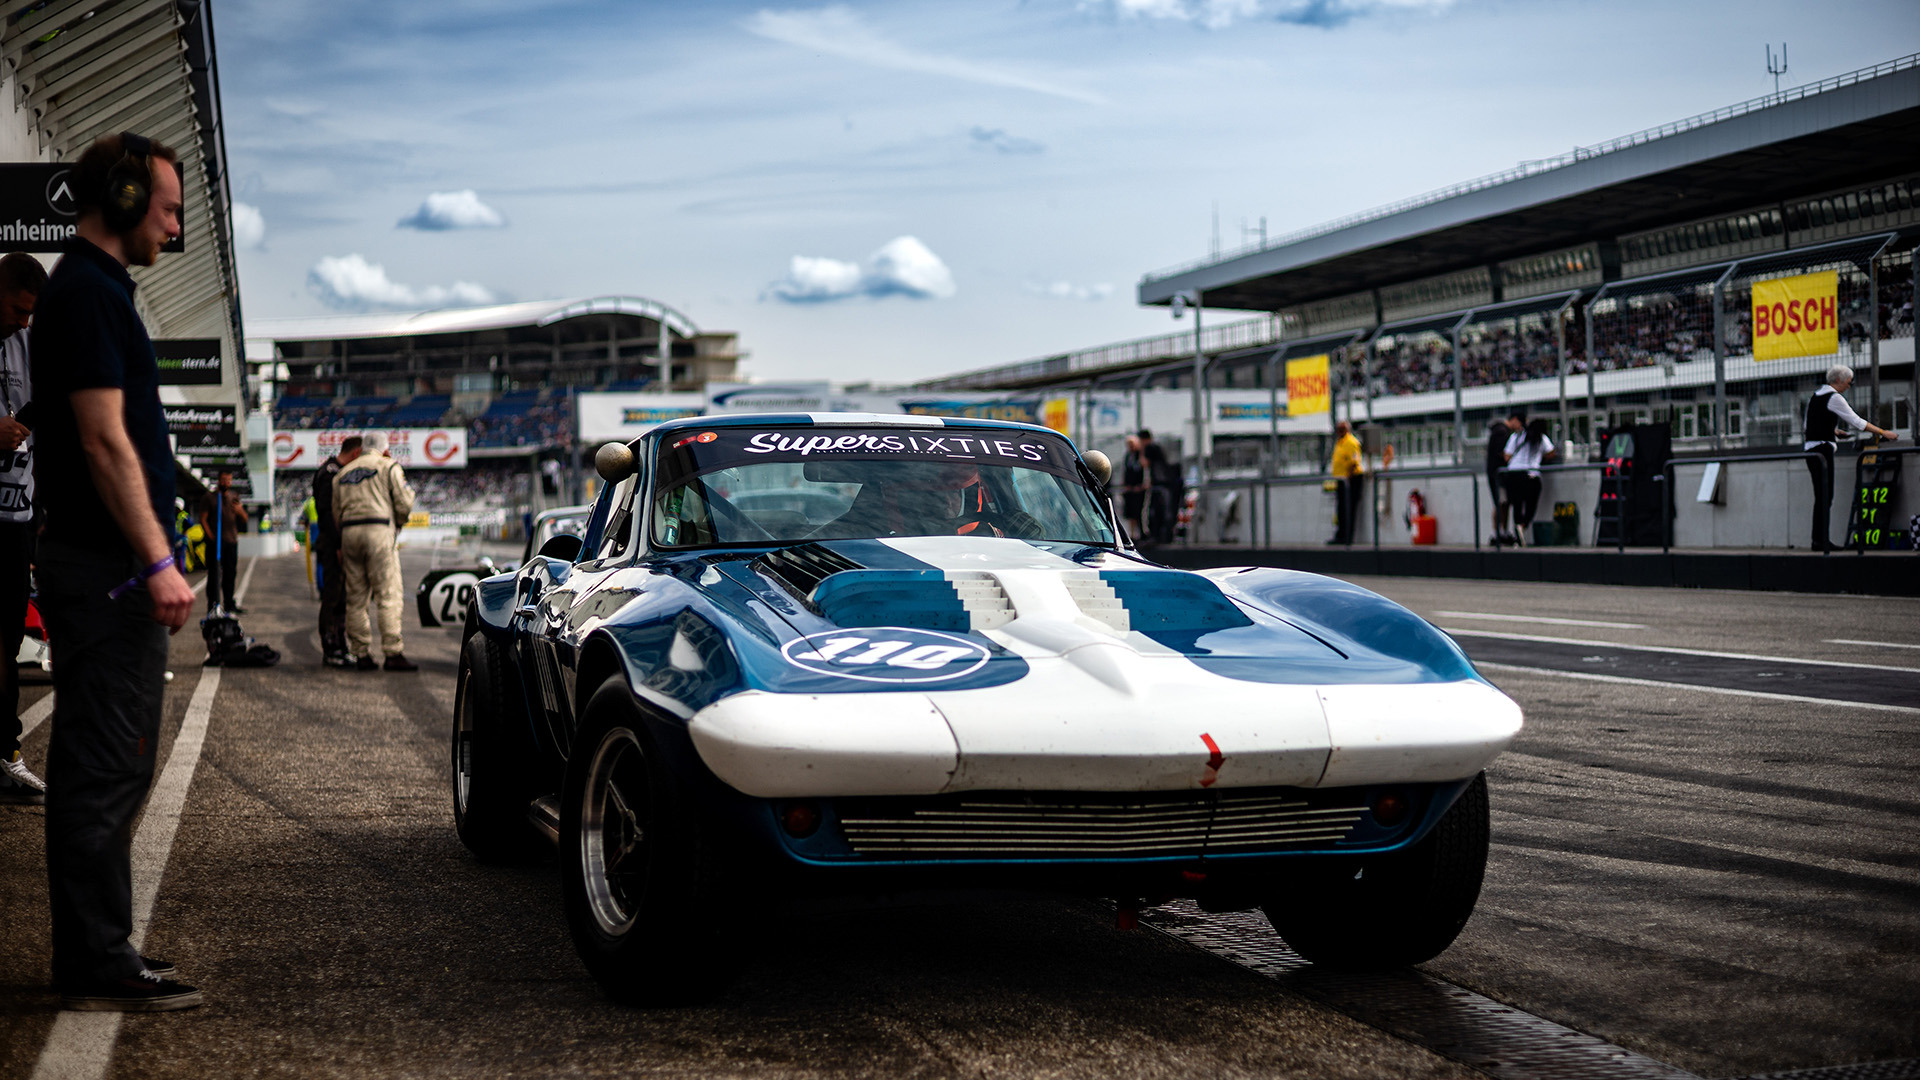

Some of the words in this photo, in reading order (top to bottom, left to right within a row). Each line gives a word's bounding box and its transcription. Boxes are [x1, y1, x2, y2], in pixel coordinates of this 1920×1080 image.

[1756, 296, 1835, 338] BOSCH
[440, 583, 469, 622] 29
[795, 637, 974, 669] 110
